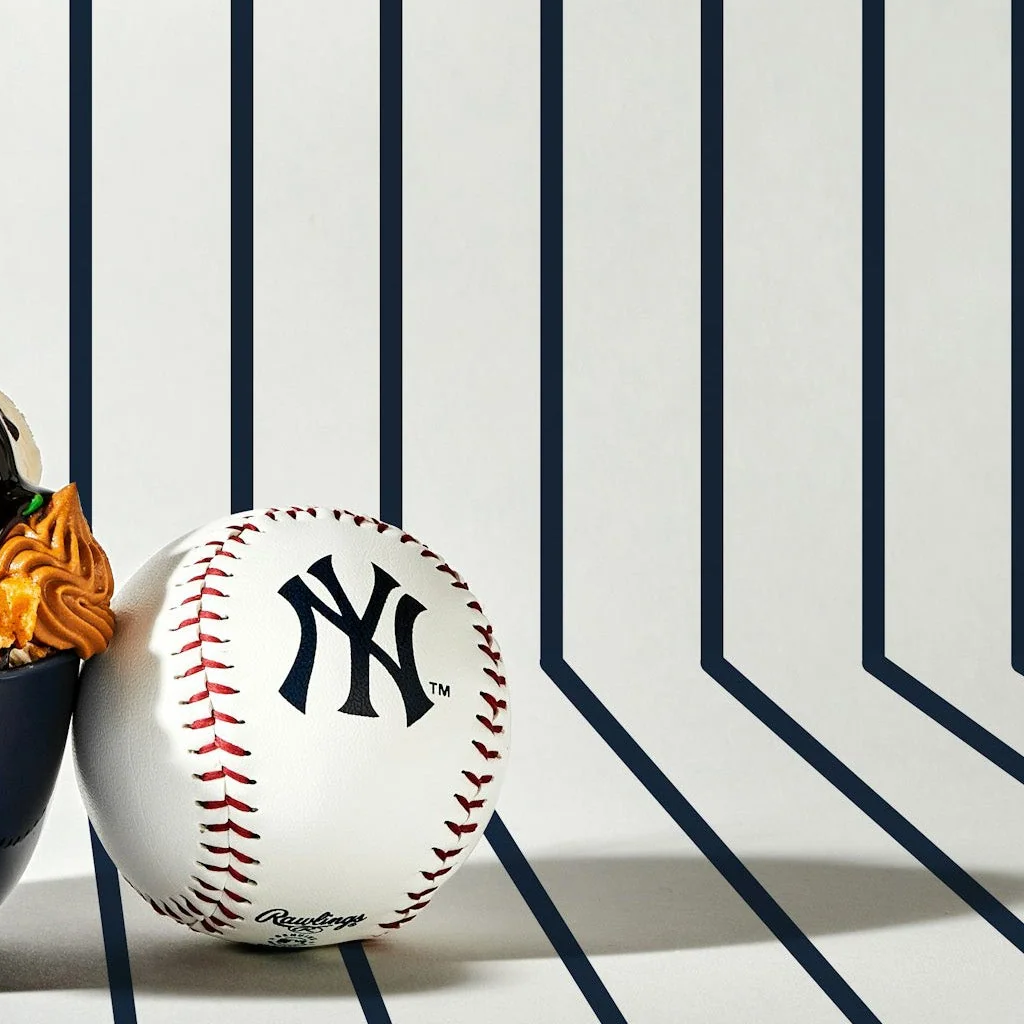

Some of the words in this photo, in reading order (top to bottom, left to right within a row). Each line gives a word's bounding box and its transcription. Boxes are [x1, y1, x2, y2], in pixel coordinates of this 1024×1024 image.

[277, 554, 435, 728] NY
[429, 681, 451, 698] TM
[254, 908, 368, 931] Rawlings
